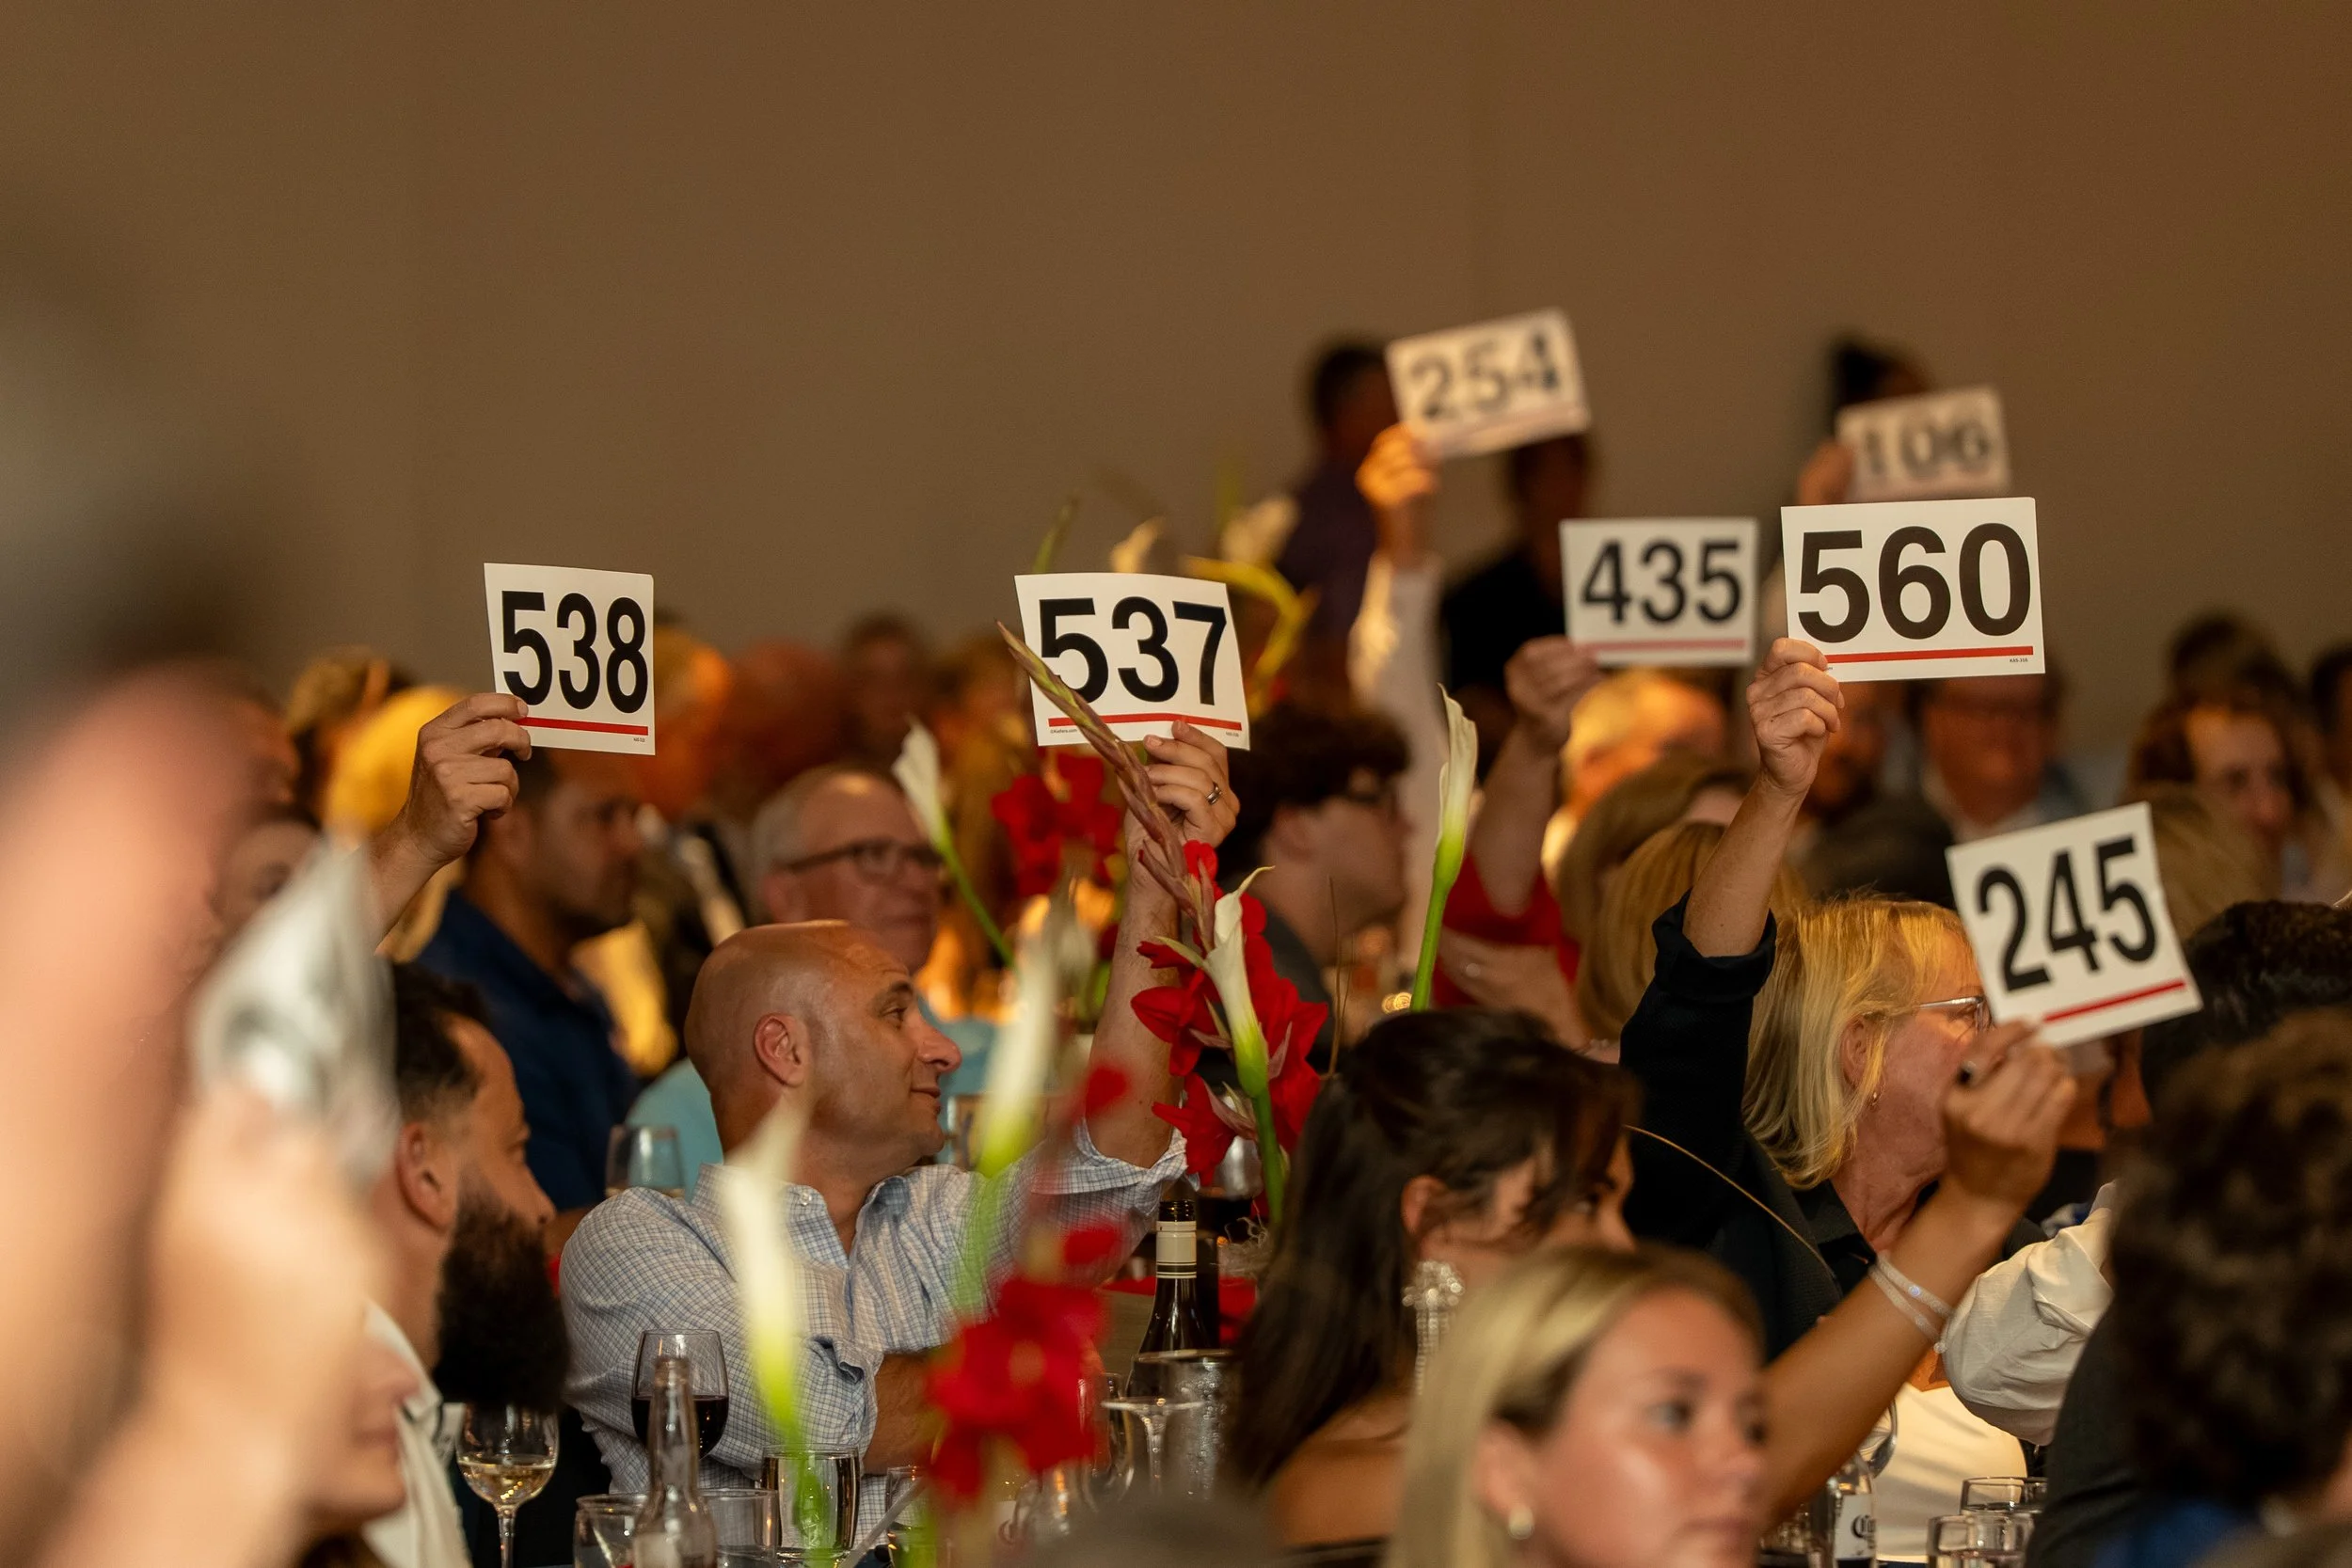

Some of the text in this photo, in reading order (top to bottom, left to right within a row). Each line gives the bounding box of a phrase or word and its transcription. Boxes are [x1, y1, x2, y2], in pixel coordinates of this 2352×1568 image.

[1410, 331, 1560, 420] 254
[1581, 539, 1742, 626] 435
[1798, 522, 2031, 643] 560
[501, 590, 648, 714] 538
[1039, 595, 1228, 706] 537
[1977, 834, 2156, 992] 245
